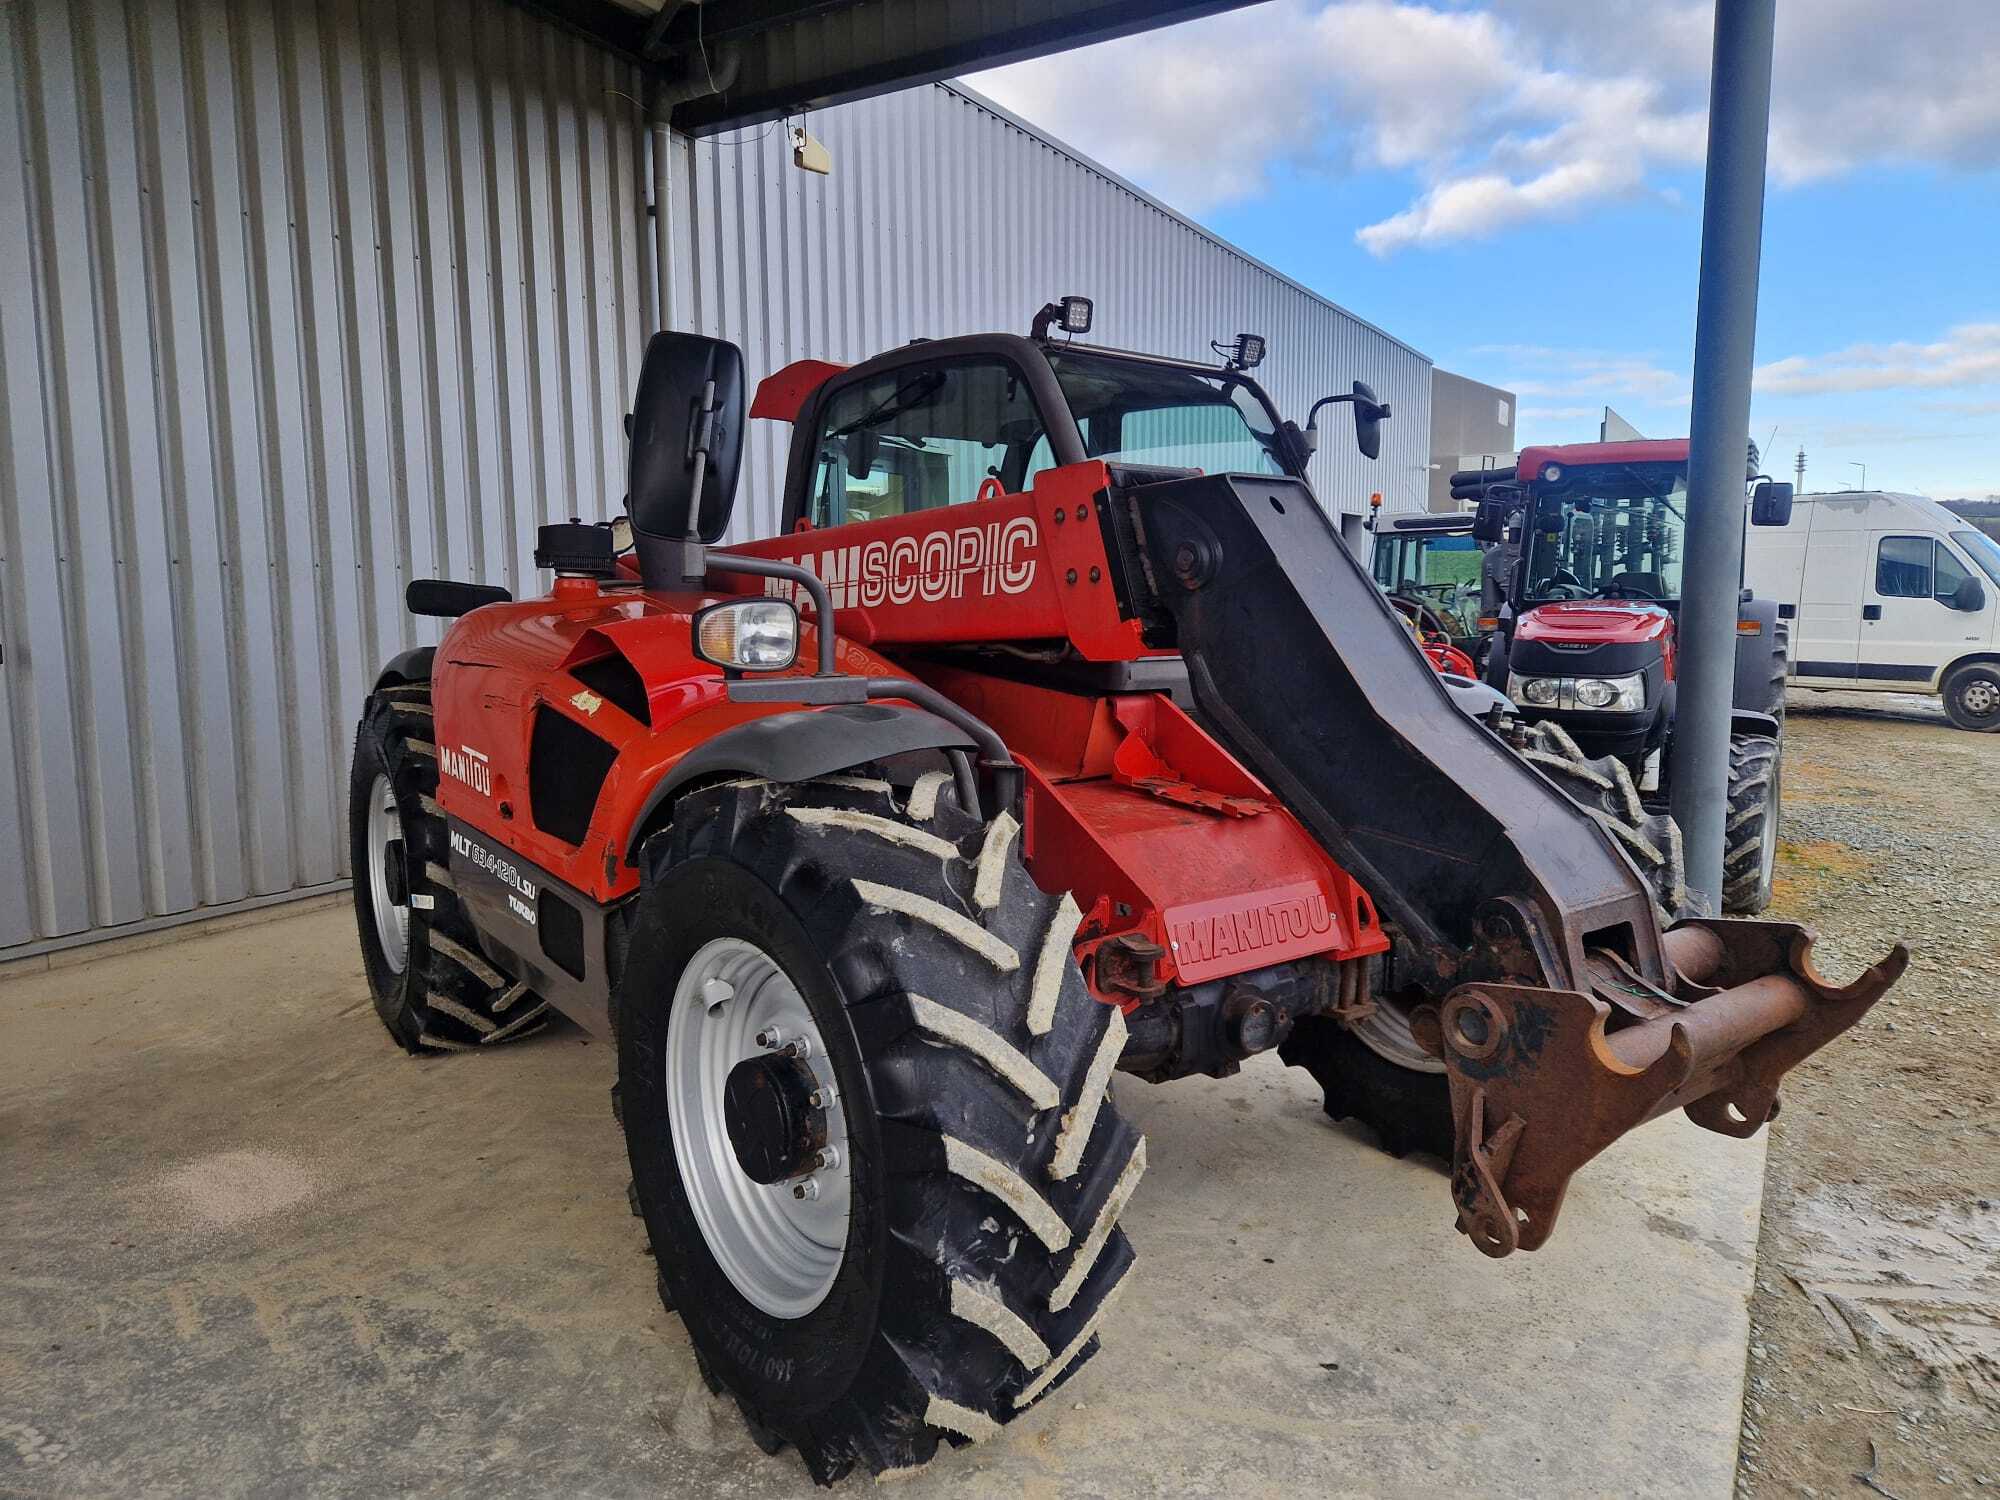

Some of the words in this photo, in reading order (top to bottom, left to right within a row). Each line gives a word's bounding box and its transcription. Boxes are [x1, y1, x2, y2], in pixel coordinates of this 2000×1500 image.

[440, 744, 491, 797] MANITOU
[450, 830, 472, 858] MLT
[508, 894, 537, 926] TURBO
[1173, 894, 1332, 966] MANITOU
